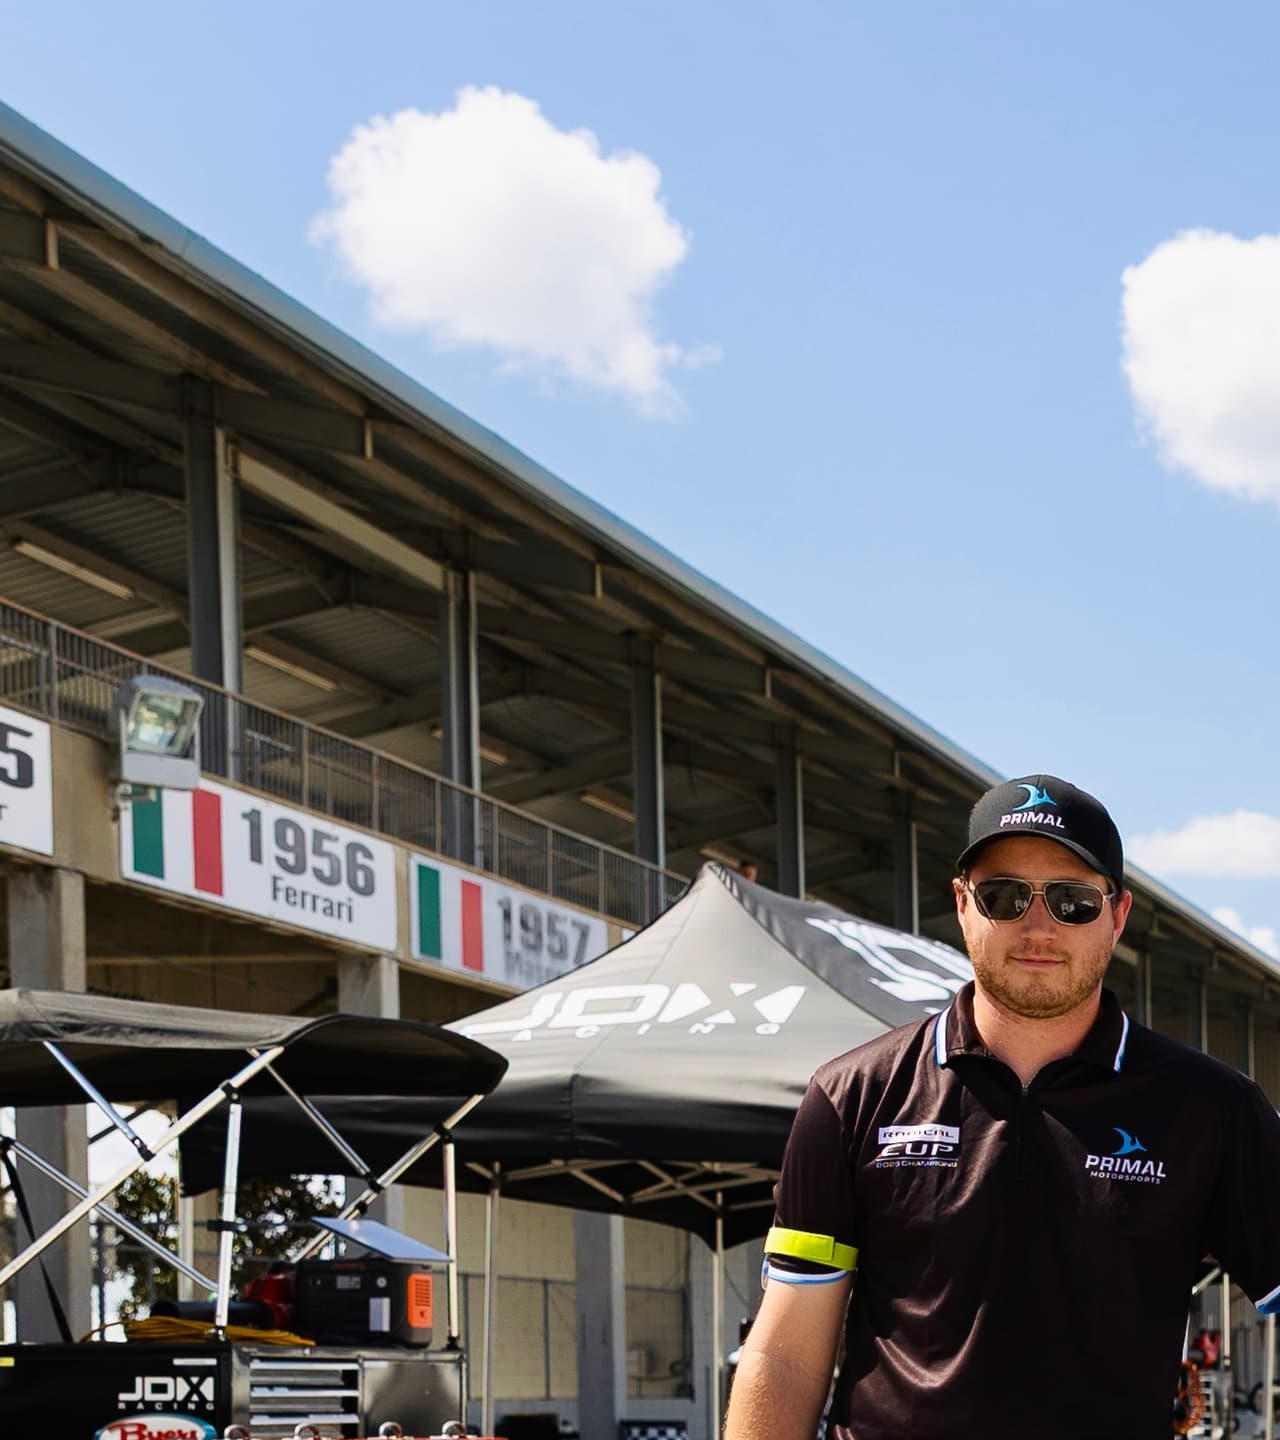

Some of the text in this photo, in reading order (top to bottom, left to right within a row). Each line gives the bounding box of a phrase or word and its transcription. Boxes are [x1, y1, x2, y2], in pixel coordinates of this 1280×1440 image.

[1000, 811, 1066, 829] PRIMAL
[241, 808, 375, 897] 1956
[271, 875, 354, 923] Ferrari
[498, 897, 590, 966] 1957
[881, 1143, 953, 1157] CUP
[1085, 1154, 1166, 1178] PRIMAL
[1089, 1171, 1160, 1185] MOTORSPORTS
[118, 1376, 214, 1401] JDX
[118, 1402, 214, 1410] RACING
